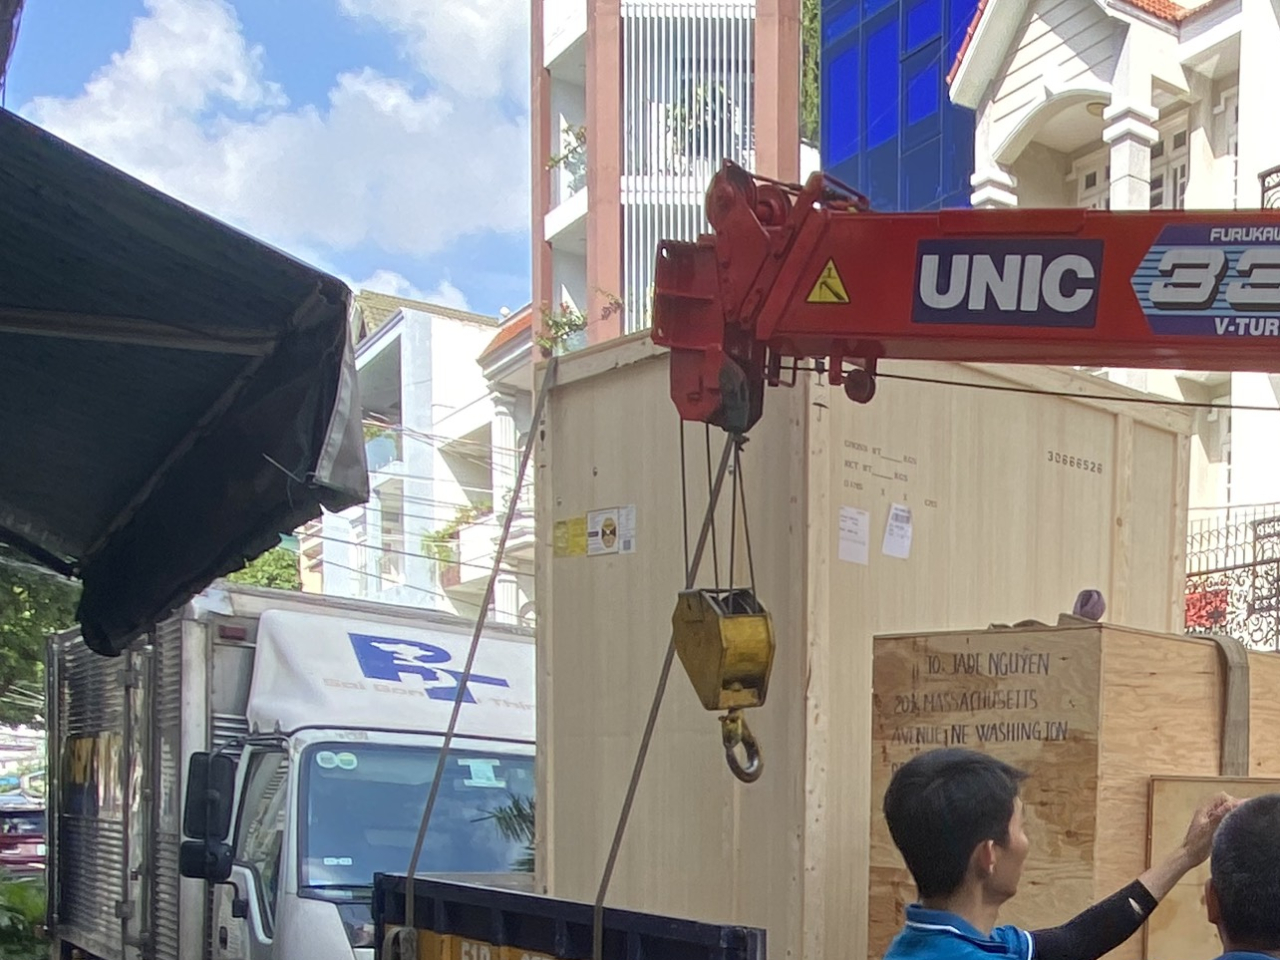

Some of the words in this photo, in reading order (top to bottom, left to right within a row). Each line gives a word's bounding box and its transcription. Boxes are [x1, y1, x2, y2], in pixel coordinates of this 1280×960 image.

[919, 254, 1095, 312] UNIC
[988, 652, 1050, 676] NGUYEN
[975, 721, 1068, 743] WASHINGTON
